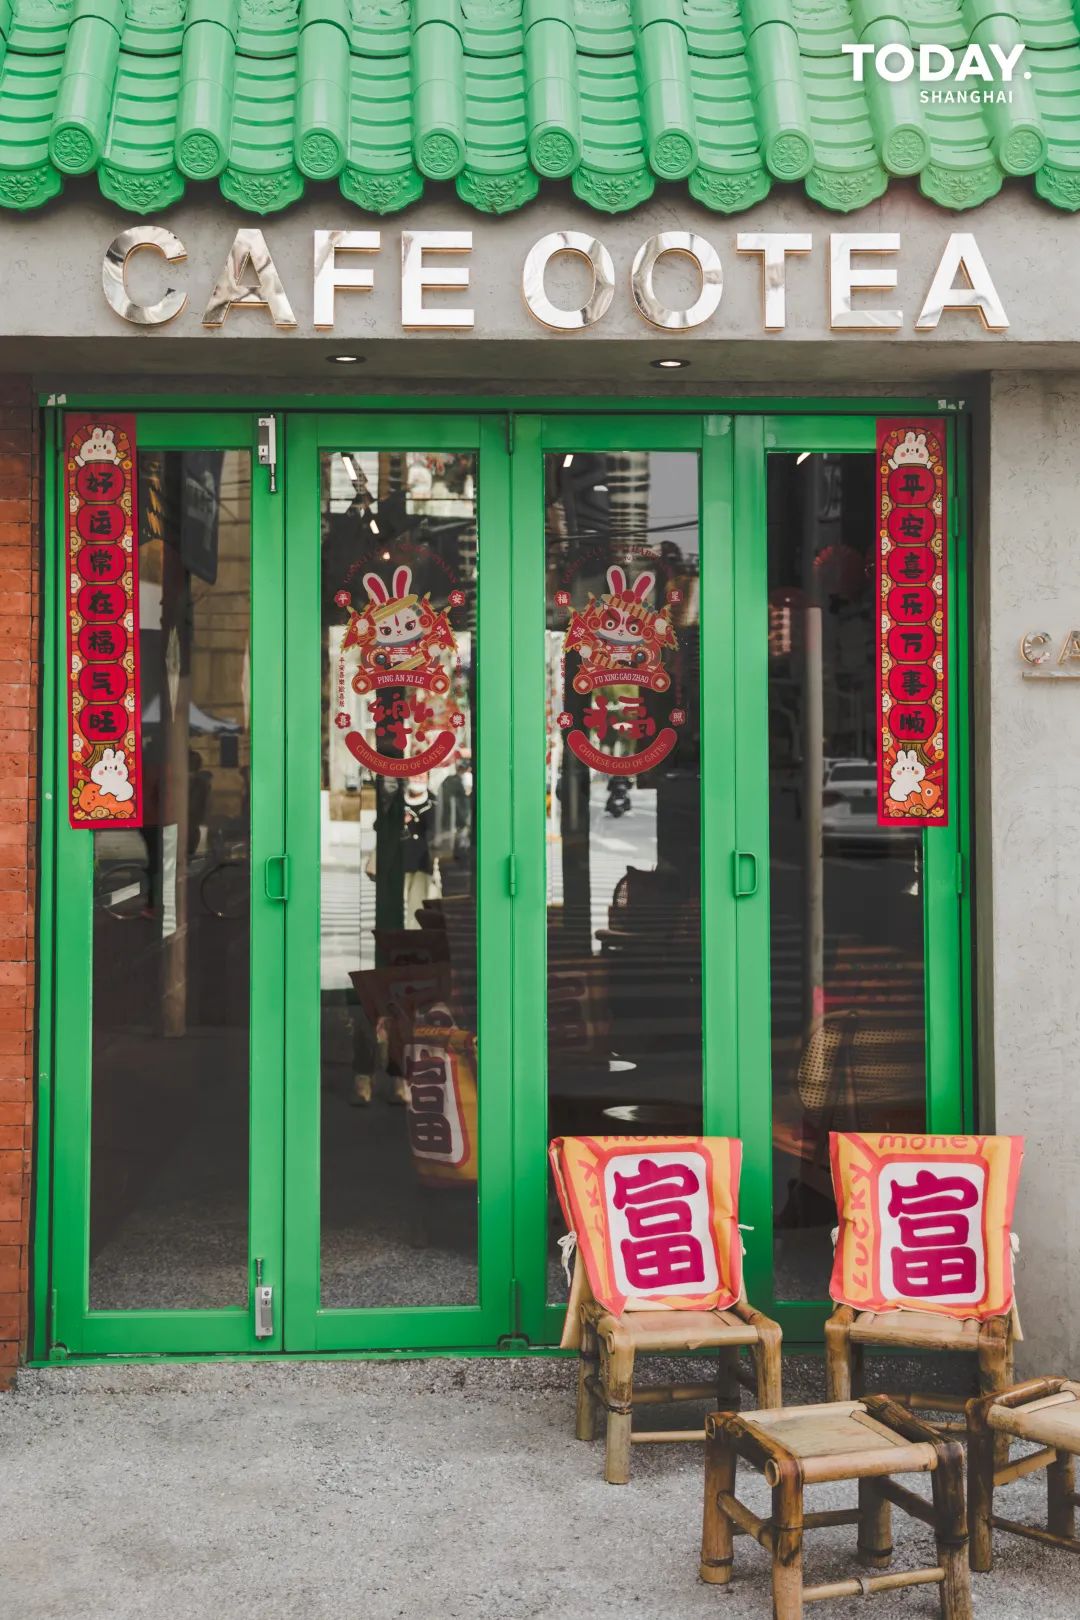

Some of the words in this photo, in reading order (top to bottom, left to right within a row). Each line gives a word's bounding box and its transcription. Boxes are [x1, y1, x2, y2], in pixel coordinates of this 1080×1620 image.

[102, 225, 475, 328] CAFE
[521, 231, 1011, 332] OOTEA
[85, 472, 117, 734] 好运常在福气旺
[898, 474, 927, 735] 平安喜乐万事顺
[377, 674, 394, 685] PING
[395, 674, 405, 682] AN
[406, 674, 414, 683] XI
[415, 675, 425, 685] LE
[594, 675, 604, 685] FU
[604, 673, 619, 682] XING
[632, 673, 650, 684] ZHAO
[356, 744, 389, 769] CHINESE
[389, 763, 409, 771] GOD
[410, 761, 421, 769] OF
[422, 744, 446, 766] GATES
[578, 743, 610, 768] CHINESE
[612, 761, 631, 769] GOD
[632, 759, 642, 767] OF
[644, 741, 667, 763] GATES
[613, 1159, 705, 1289] 富
[849, 1163, 870, 1290] LUCKY
[888, 1170, 979, 1297] 富
